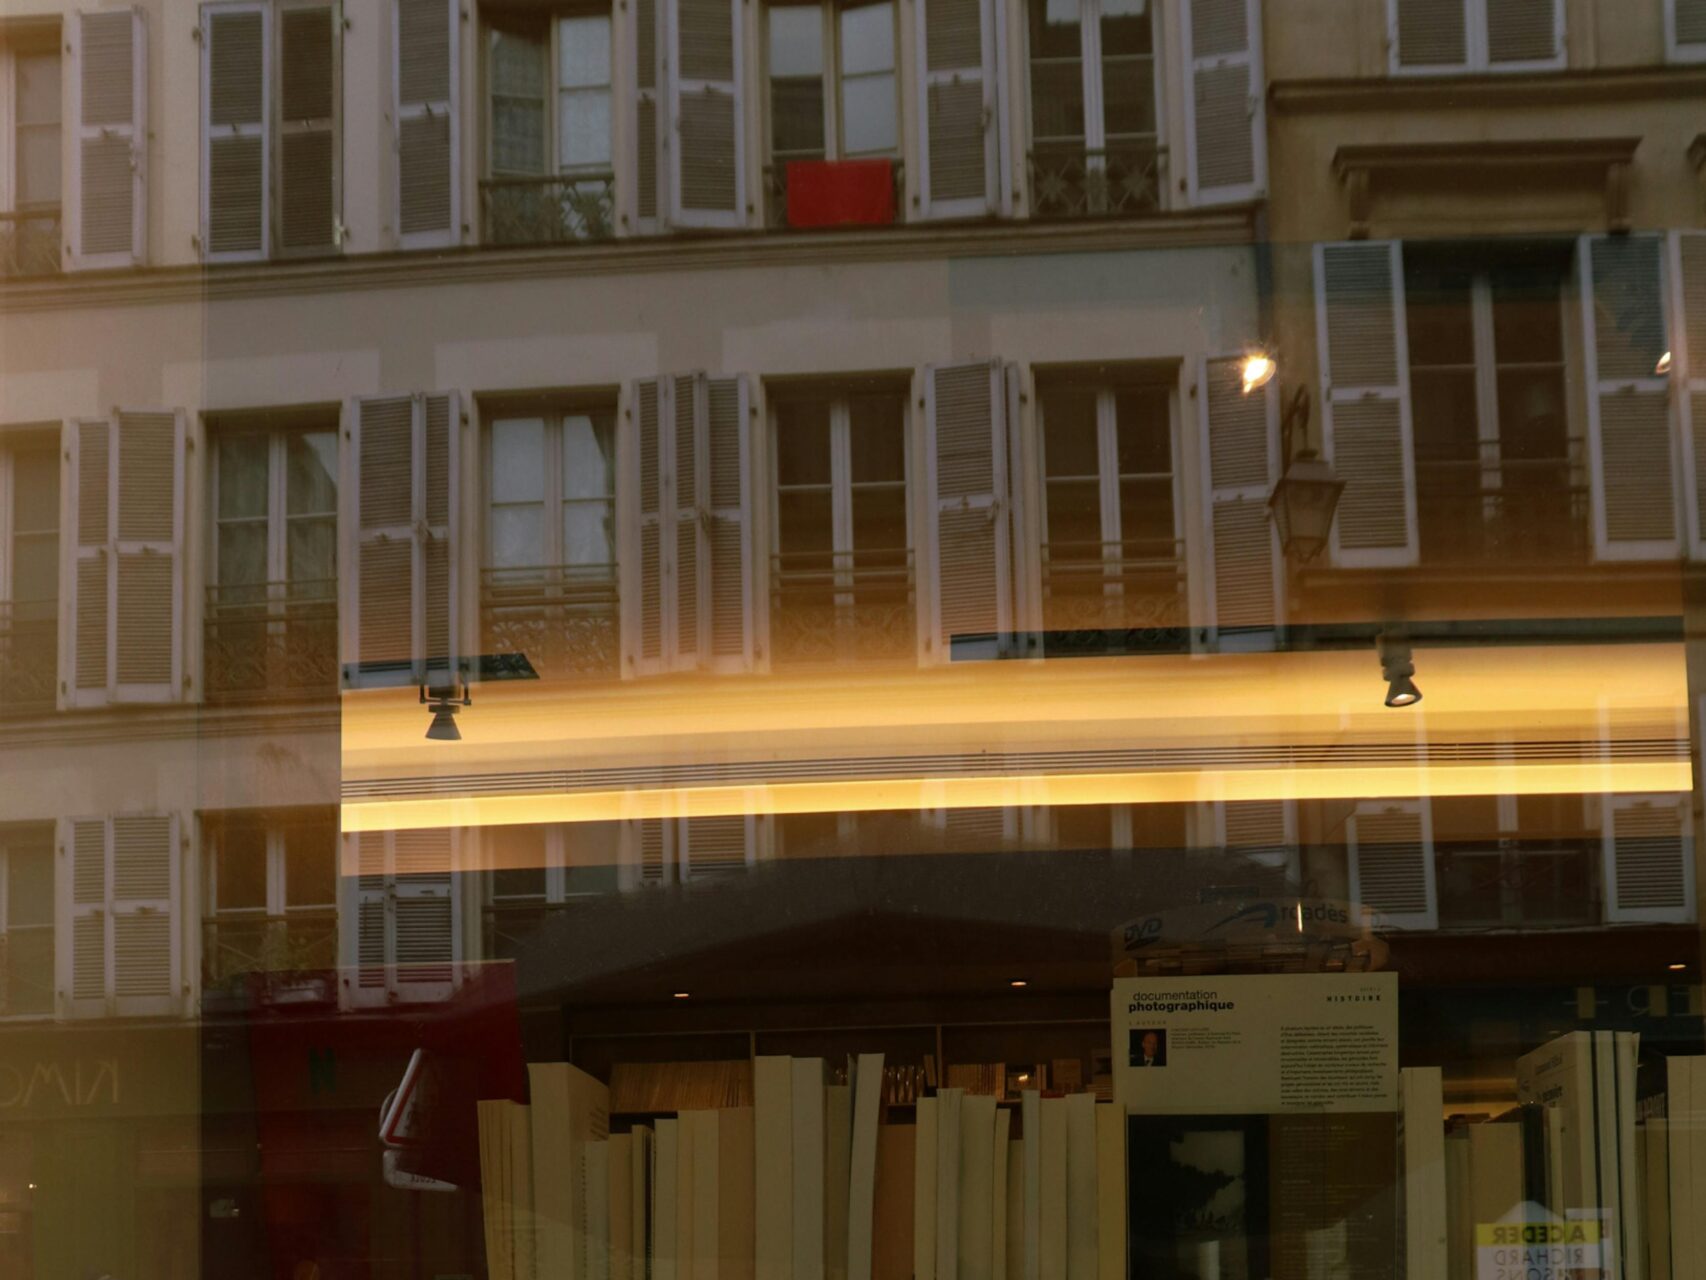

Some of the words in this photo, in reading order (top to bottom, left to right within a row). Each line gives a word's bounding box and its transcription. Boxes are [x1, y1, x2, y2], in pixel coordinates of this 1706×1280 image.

[1123, 917, 1163, 943] DVD
[1133, 990, 1218, 1001] documentation
[1129, 1000, 1235, 1014] photographique
